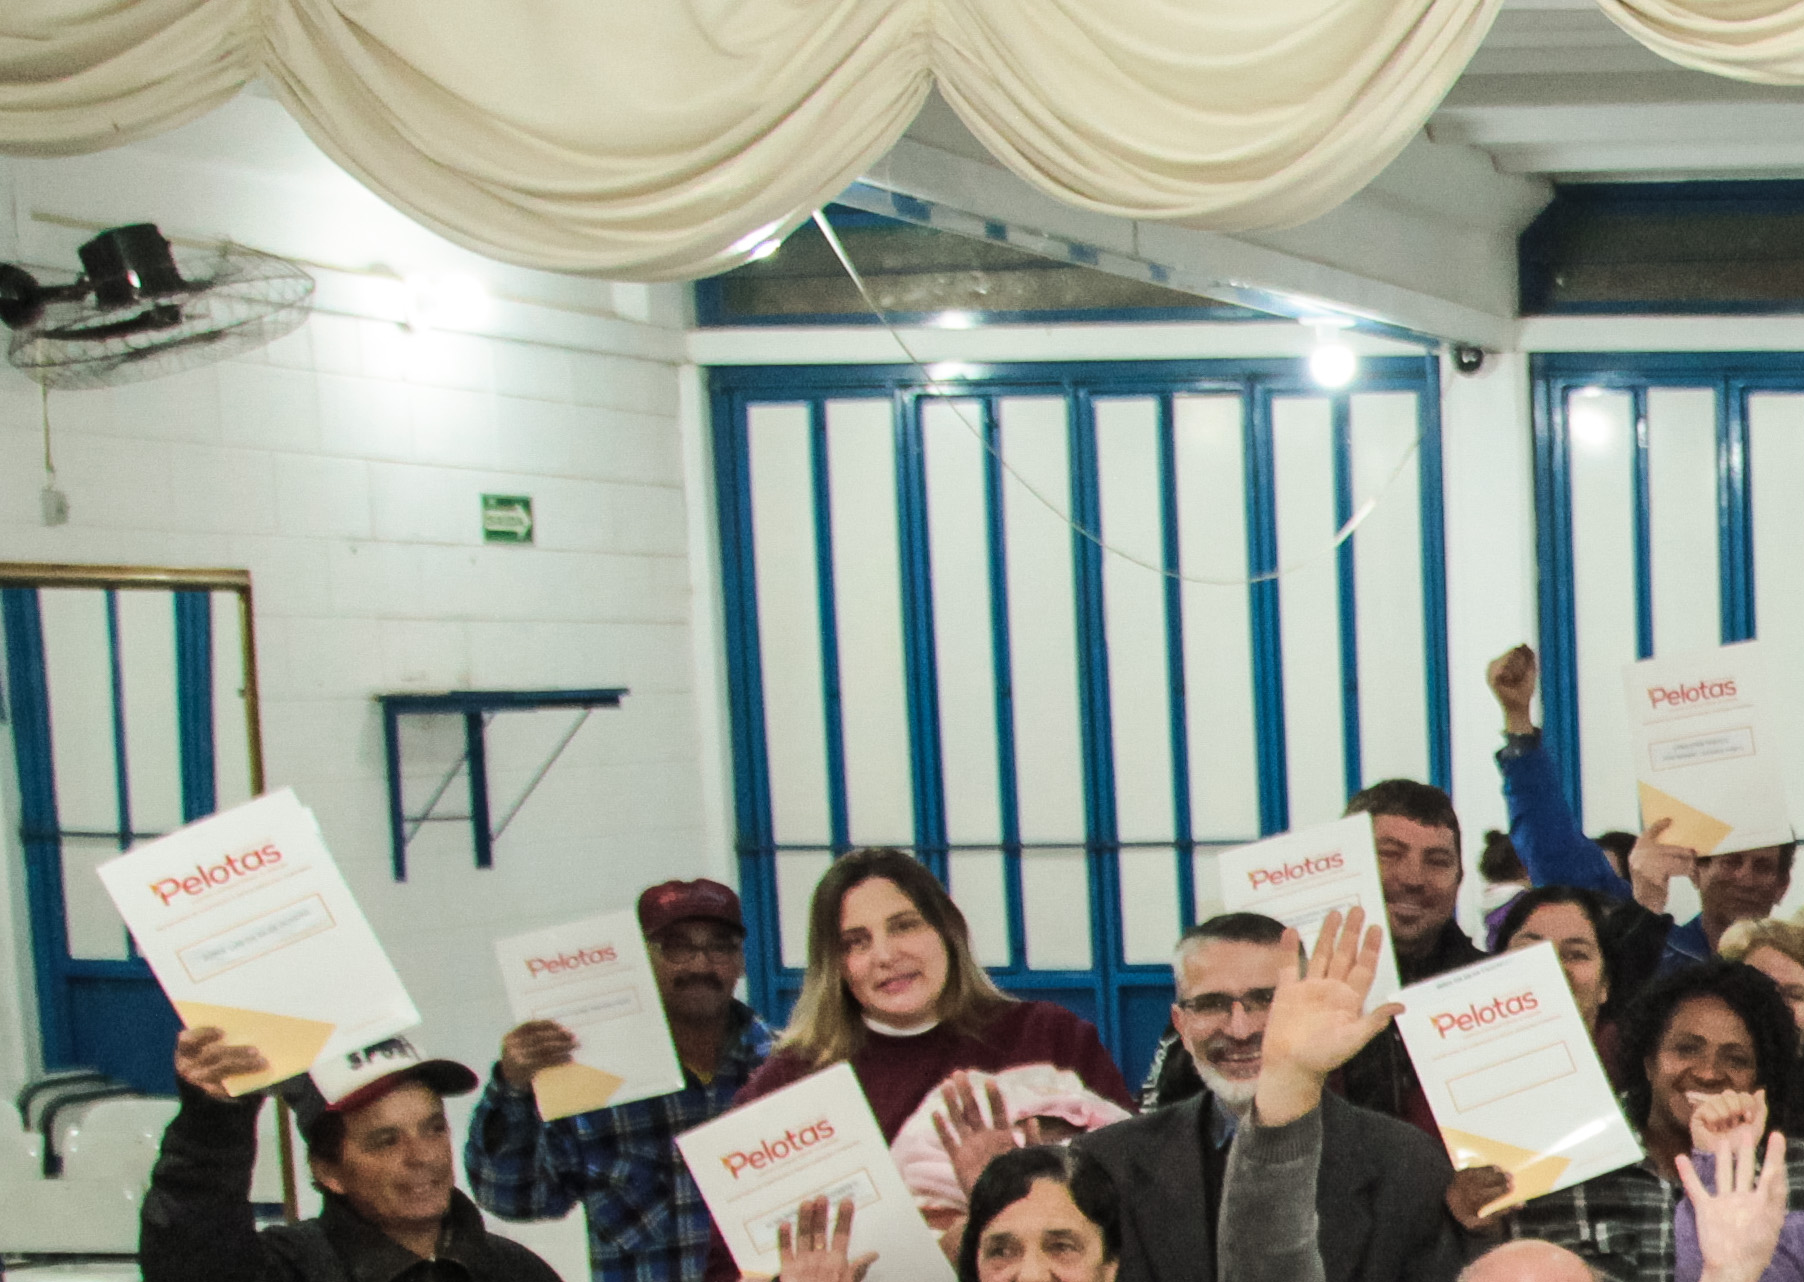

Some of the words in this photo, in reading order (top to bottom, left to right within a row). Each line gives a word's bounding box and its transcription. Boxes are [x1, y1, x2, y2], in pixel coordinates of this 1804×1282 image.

[1648, 680, 1737, 709] Pelotas
[150, 843, 283, 906] Pelotas
[1248, 851, 1344, 890] Pelotas
[525, 945, 618, 979] Pelotas
[1430, 991, 1539, 1039] Pelotas
[720, 1119, 835, 1180] Pelotas
